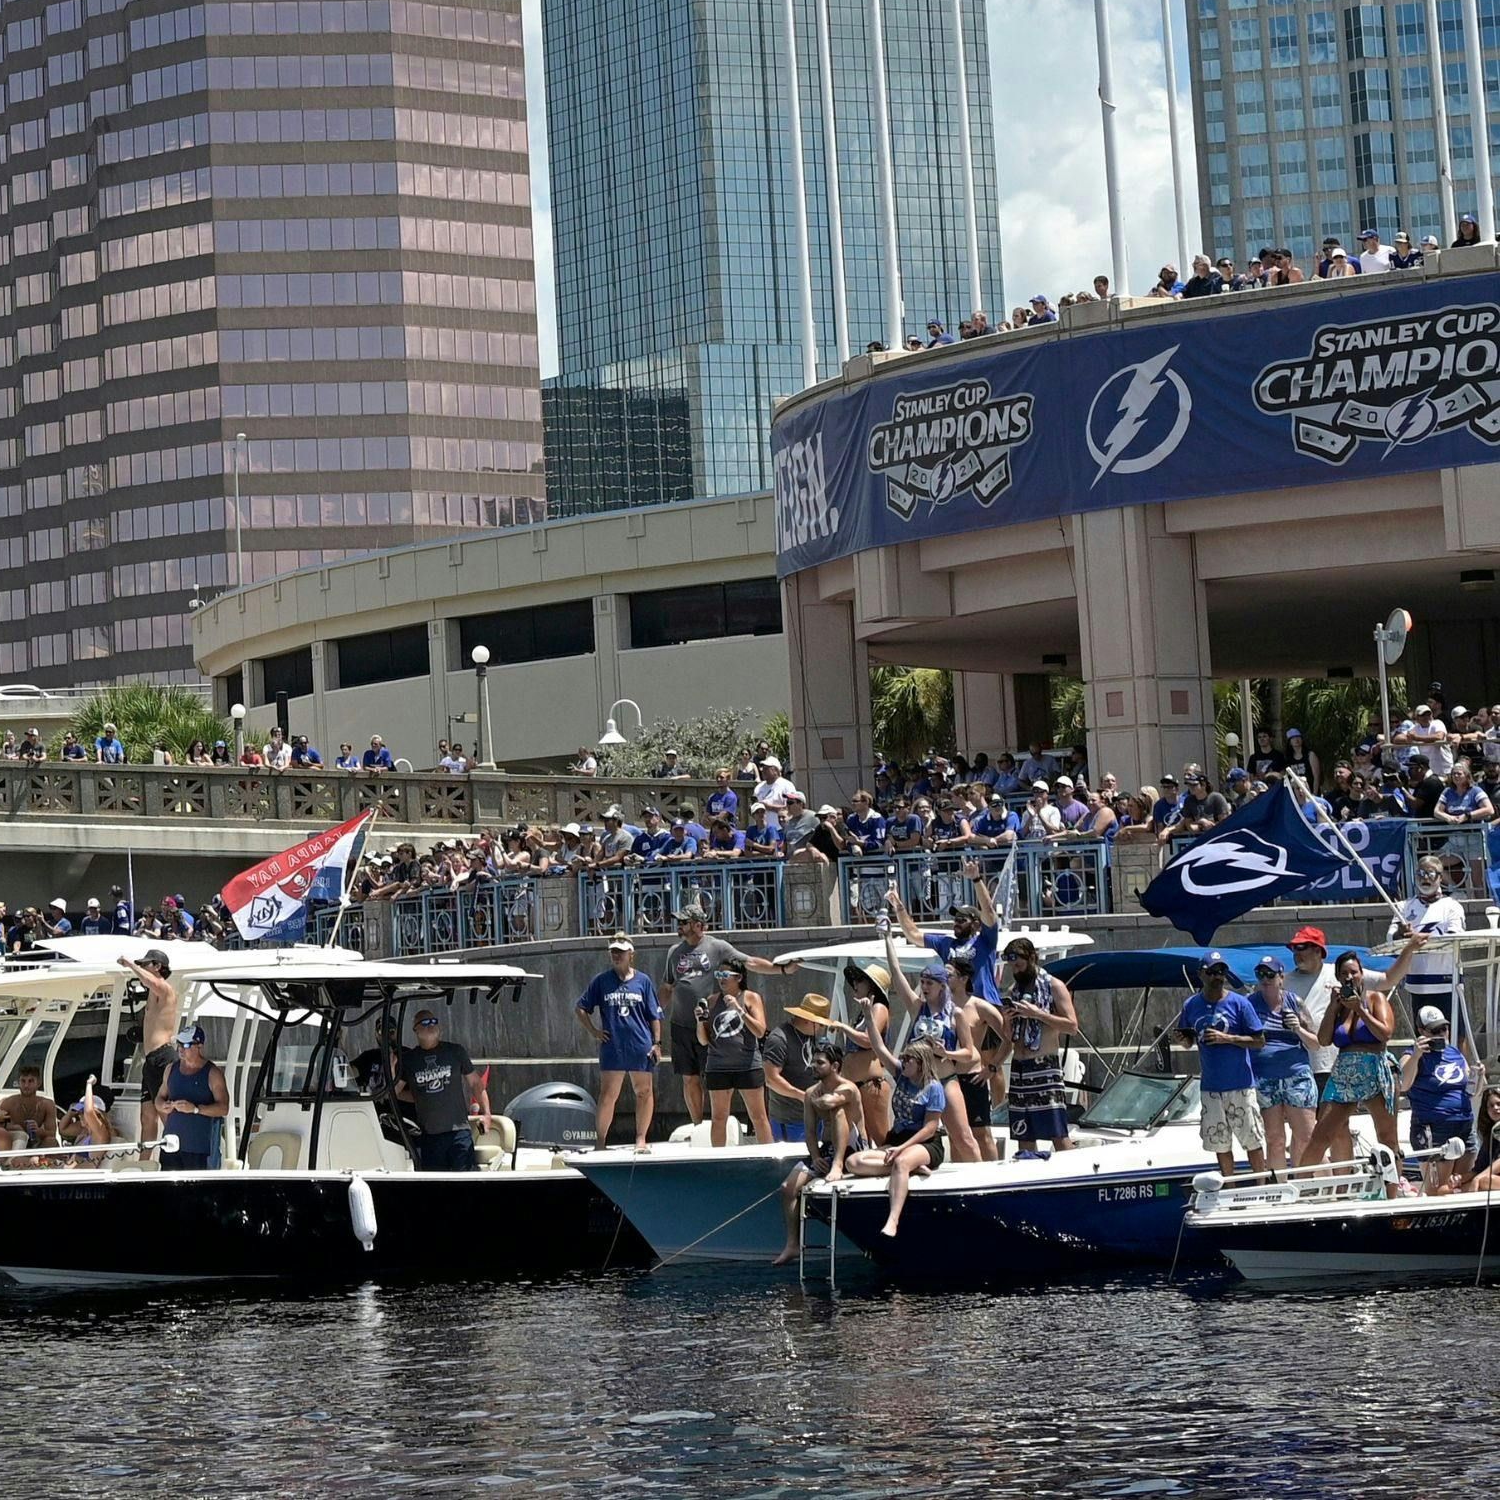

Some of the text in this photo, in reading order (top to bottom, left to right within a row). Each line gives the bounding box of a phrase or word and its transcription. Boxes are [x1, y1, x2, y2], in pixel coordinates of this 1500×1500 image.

[1319, 312, 1496, 358] STANLEY CUP
[1258, 338, 1500, 405] CHAMPIO
[895, 386, 987, 422] STANLEY CUP
[1349, 393, 1470, 424] 20 21
[869, 401, 1029, 467] CHAMPIONS
[911, 469, 928, 485] 20
[416, 1069, 452, 1084] CHAMPS
[571, 1130, 598, 1140] YAMAHA
[1098, 1185, 1153, 1202] FL 7286 RS
